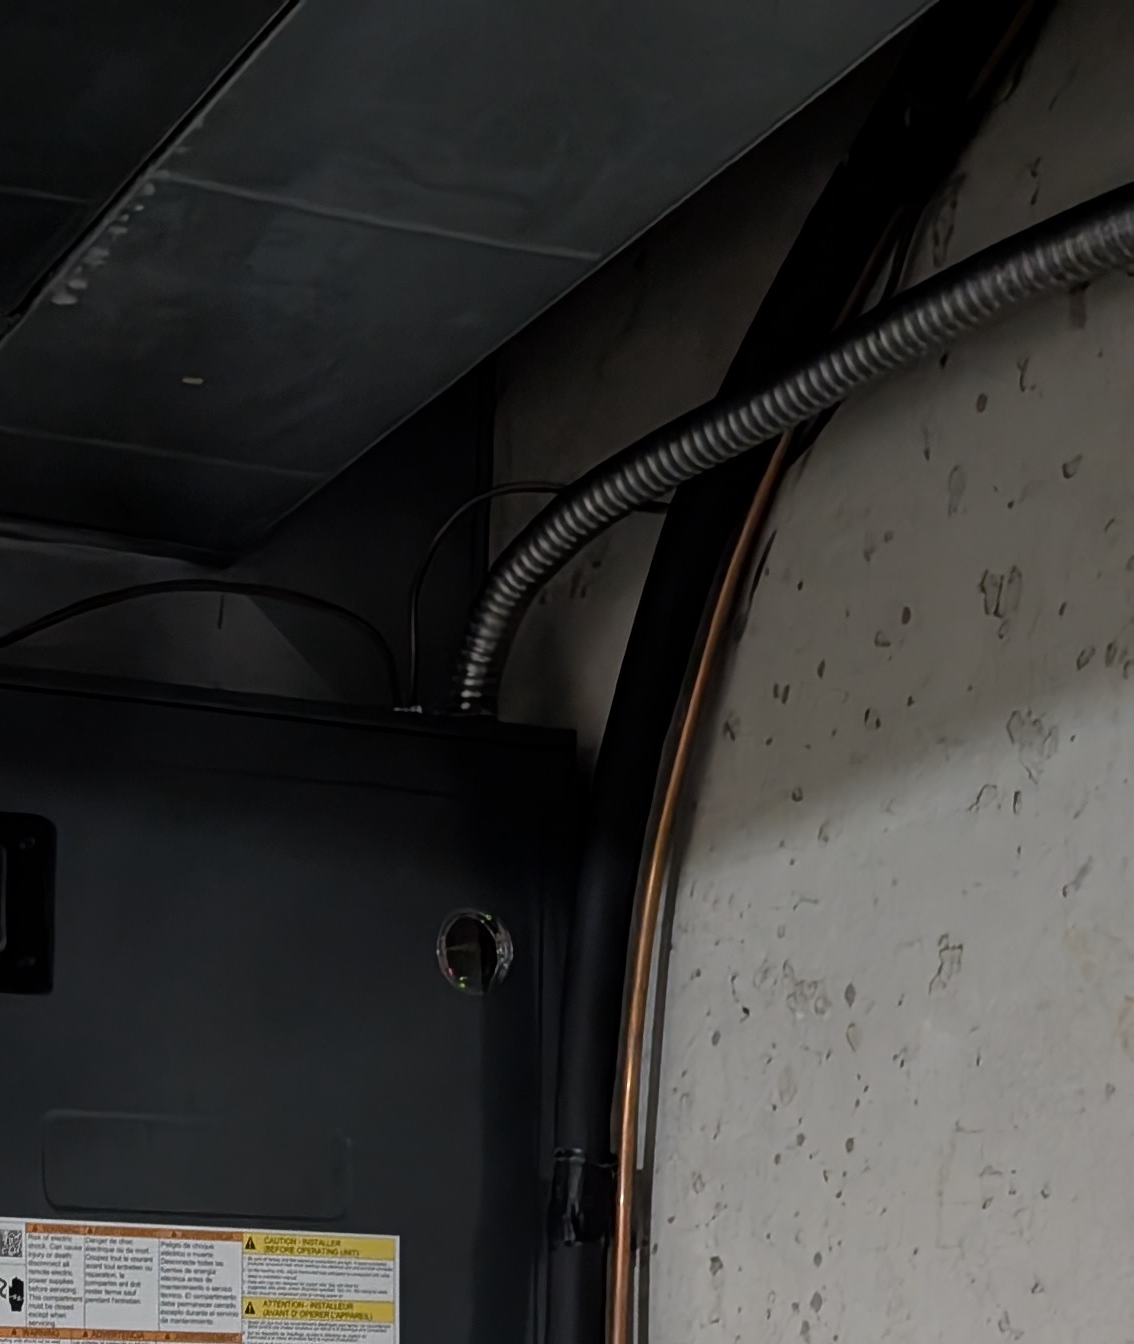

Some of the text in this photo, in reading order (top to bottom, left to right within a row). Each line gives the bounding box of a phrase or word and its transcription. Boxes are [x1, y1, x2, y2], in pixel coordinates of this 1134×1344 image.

[264, 1236, 296, 1245] CAUTION
[302, 1238, 341, 1247] INSTALLER
[297, 1247, 339, 1256] OPERATING
[263, 1299, 304, 1309] ATTENTION
[309, 1301, 354, 1311] INSTALLEUR
